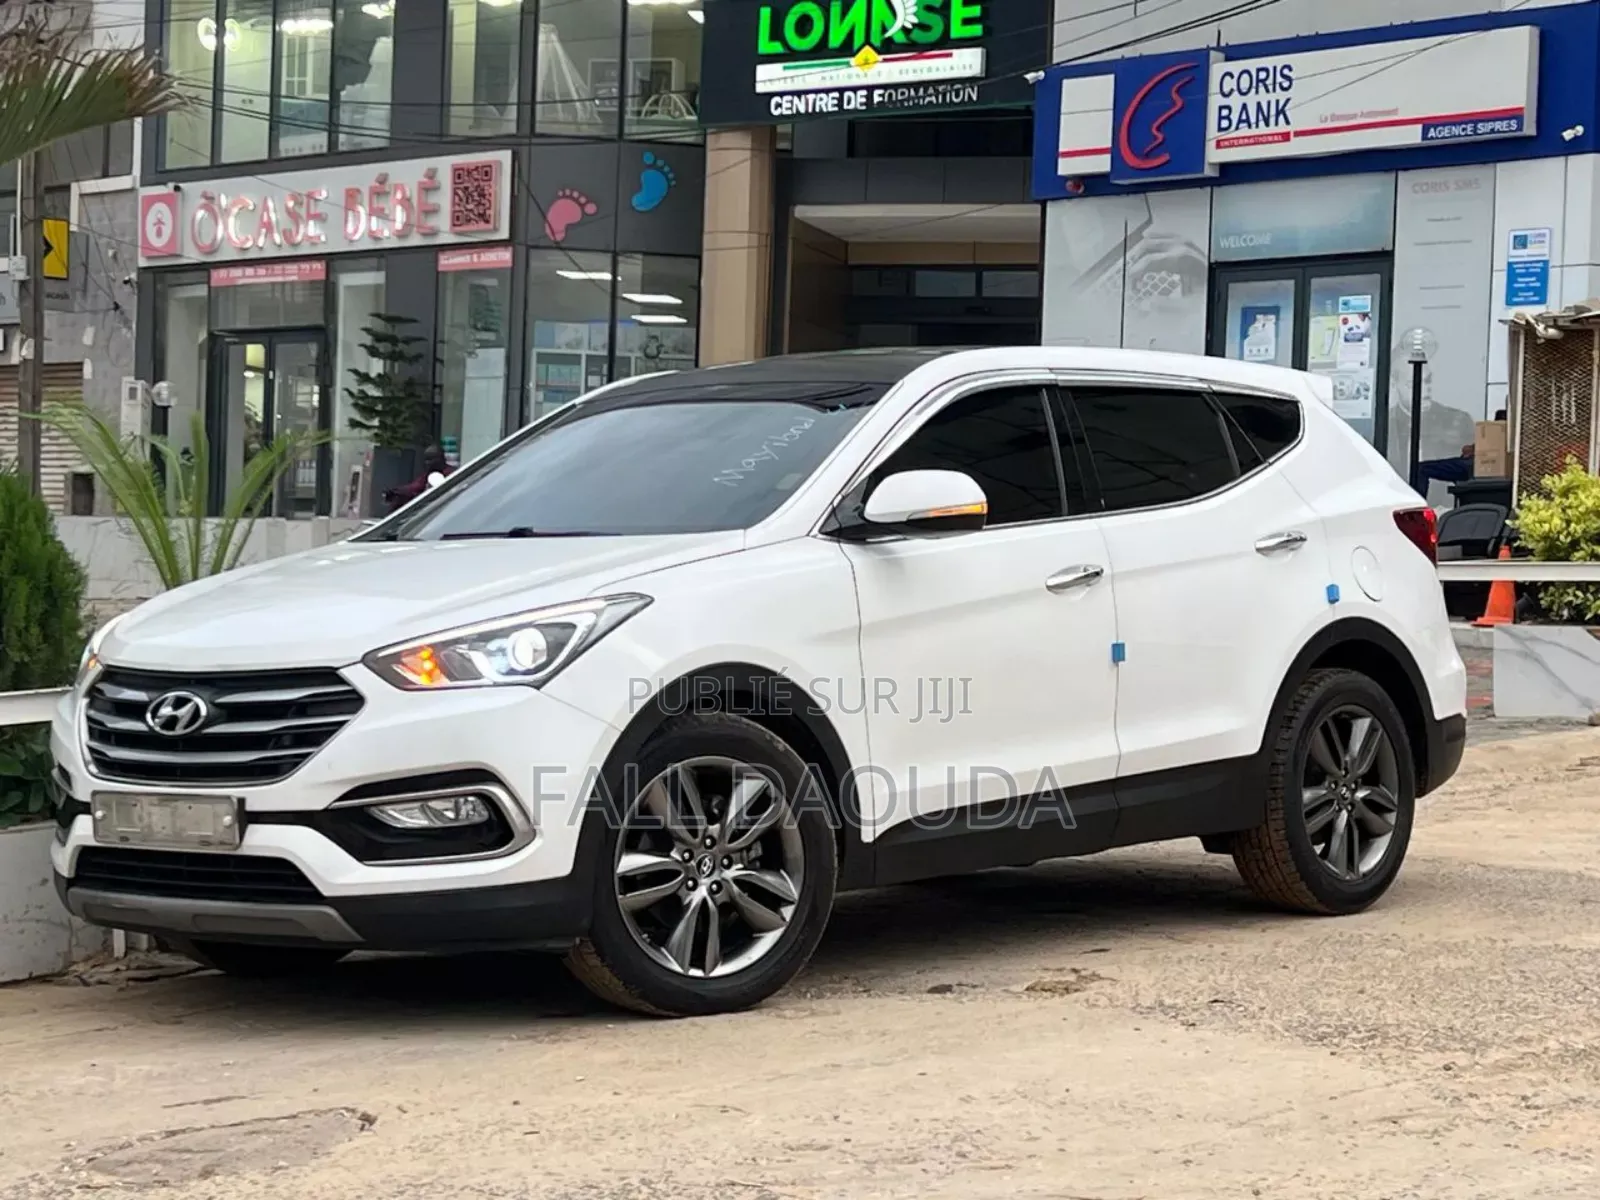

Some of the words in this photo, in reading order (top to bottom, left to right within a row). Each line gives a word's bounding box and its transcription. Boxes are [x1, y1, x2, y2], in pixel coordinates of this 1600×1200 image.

[1219, 64, 1293, 98] CORIS
[770, 92, 838, 116] CENTRE
[843, 90, 867, 110] DE
[873, 83, 978, 107] FORMATION
[1217, 97, 1291, 133] BANK
[1219, 134, 1284, 147] INTERNATIONAL
[1428, 124, 1474, 138] AGENCE
[1477, 119, 1518, 133] SIPRES
[1411, 181, 1450, 194] CORIS
[344, 167, 441, 241] BÉBÉ
[1219, 233, 1272, 249] WELCOME
